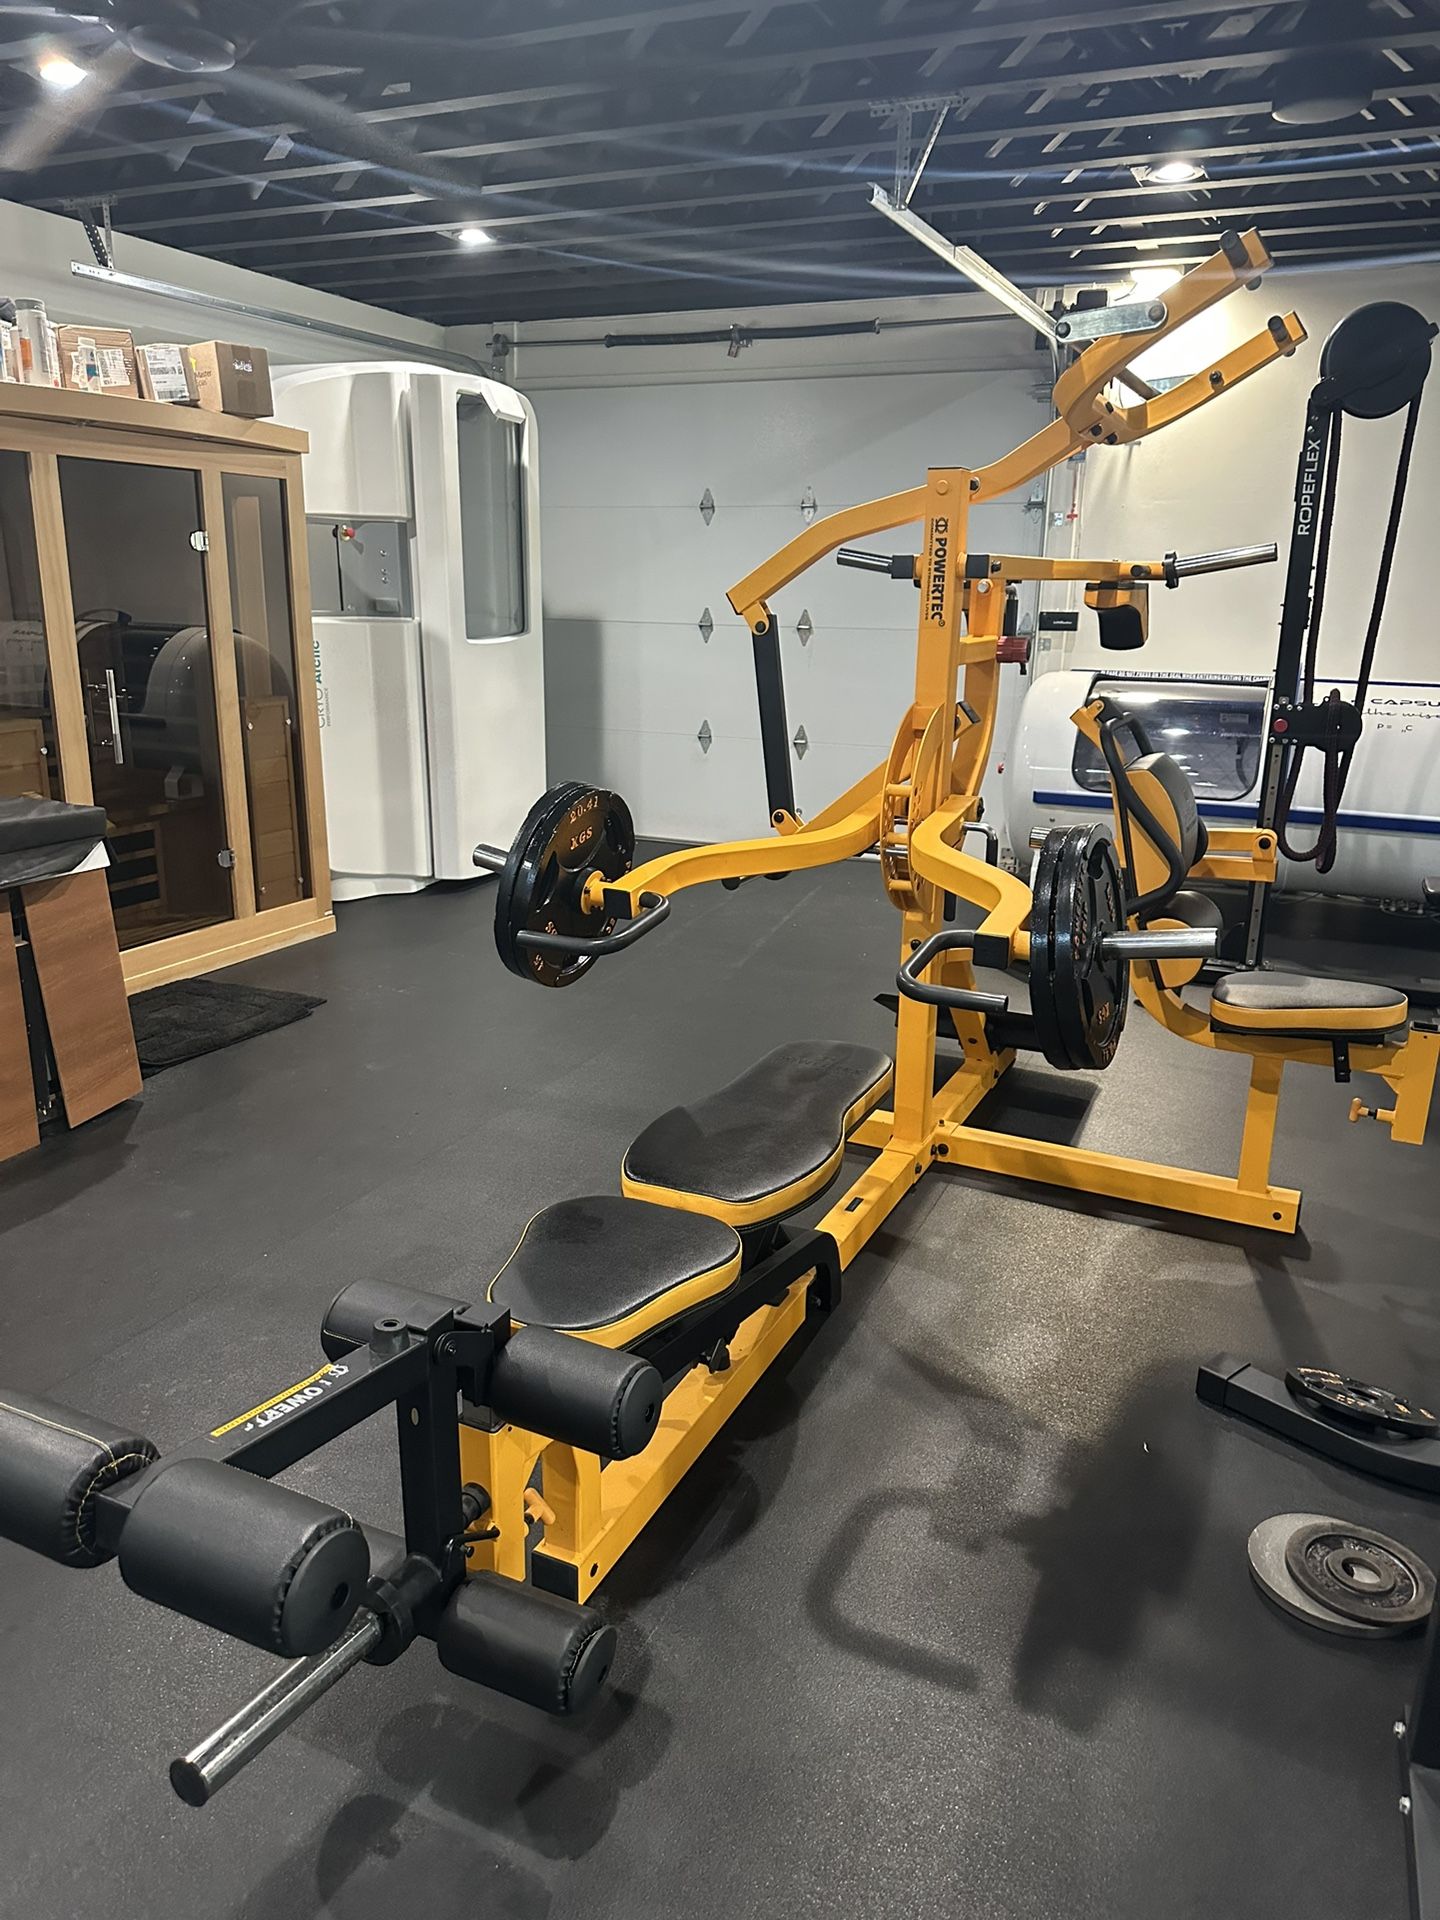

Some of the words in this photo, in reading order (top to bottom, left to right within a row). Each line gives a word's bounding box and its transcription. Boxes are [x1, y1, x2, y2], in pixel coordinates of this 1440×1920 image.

[1297, 439, 1321, 535] ROPEFLEX
[931, 538, 947, 621] POWERTEC
[569, 796, 599, 824] 20.41
